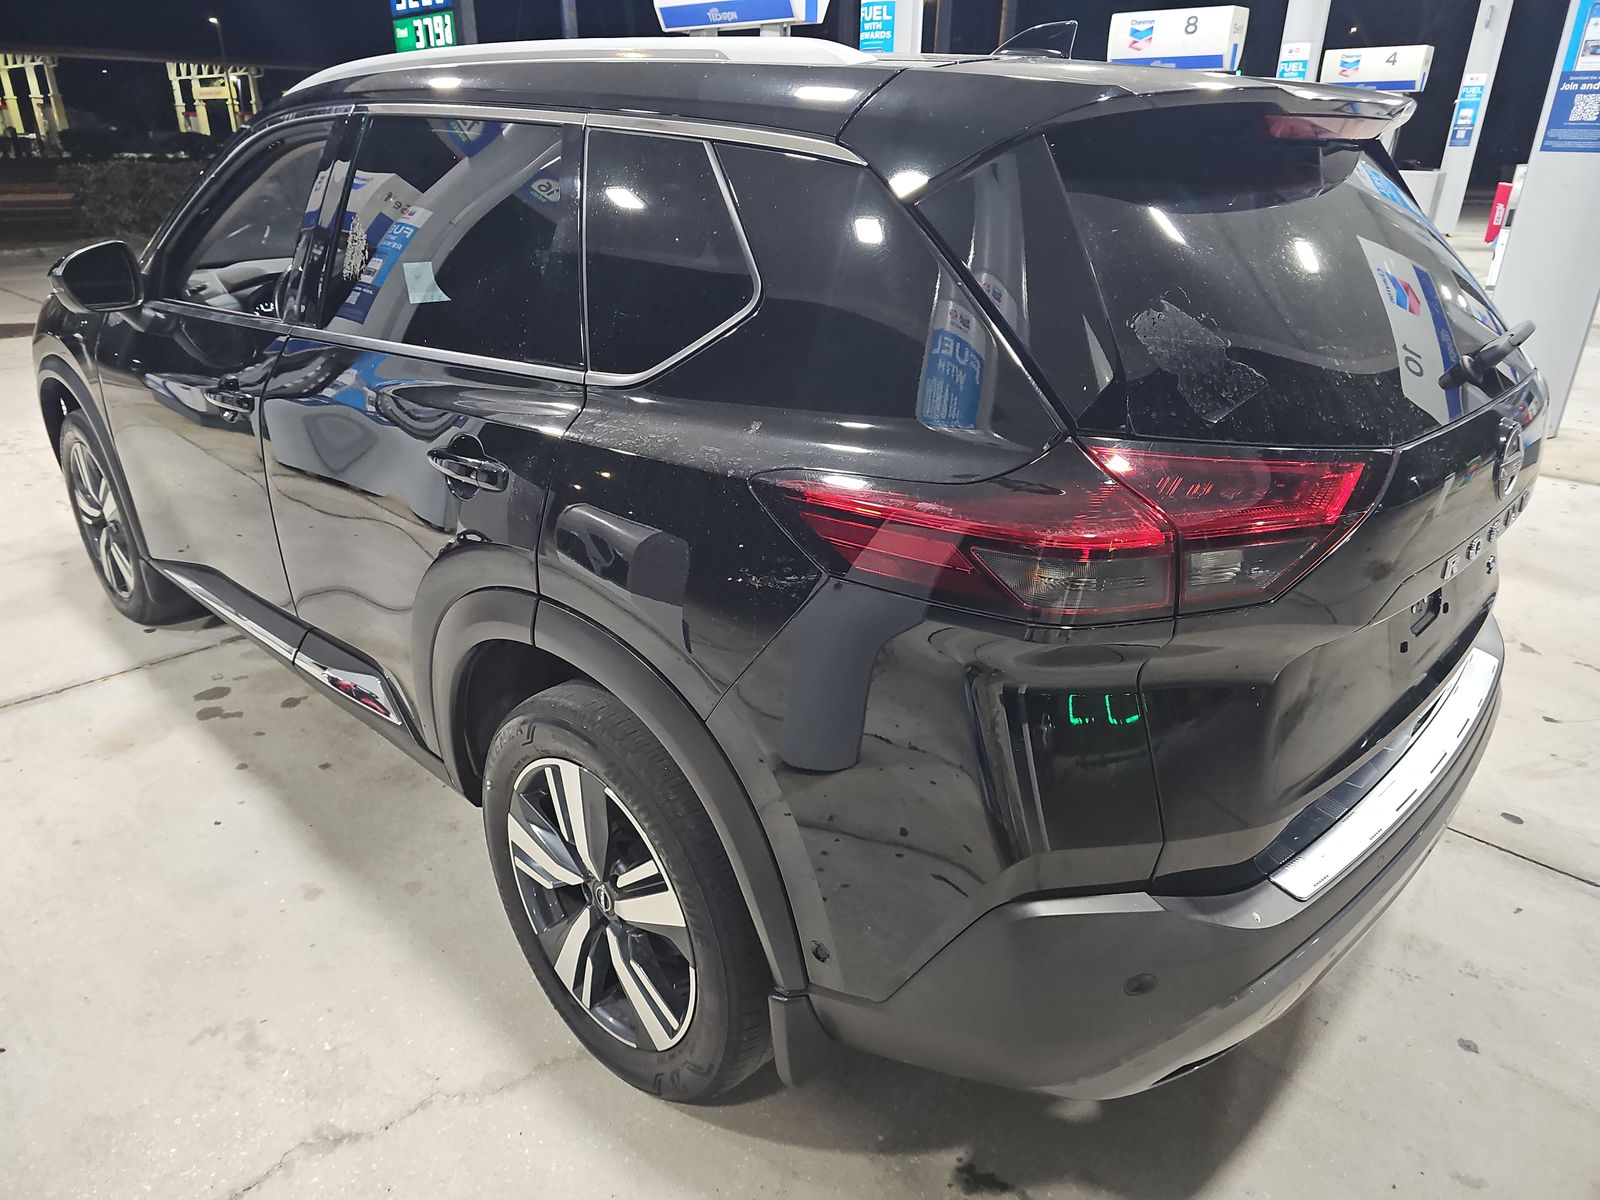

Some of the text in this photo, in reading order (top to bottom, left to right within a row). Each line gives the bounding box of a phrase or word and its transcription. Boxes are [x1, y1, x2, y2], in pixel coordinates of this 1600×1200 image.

[1184, 15, 1199, 35] 8
[860, 30, 892, 41] EWARDS
[1385, 51, 1398, 66] 4
[1280, 61, 1306, 73] FUEL
[1560, 81, 1600, 91] Join and
